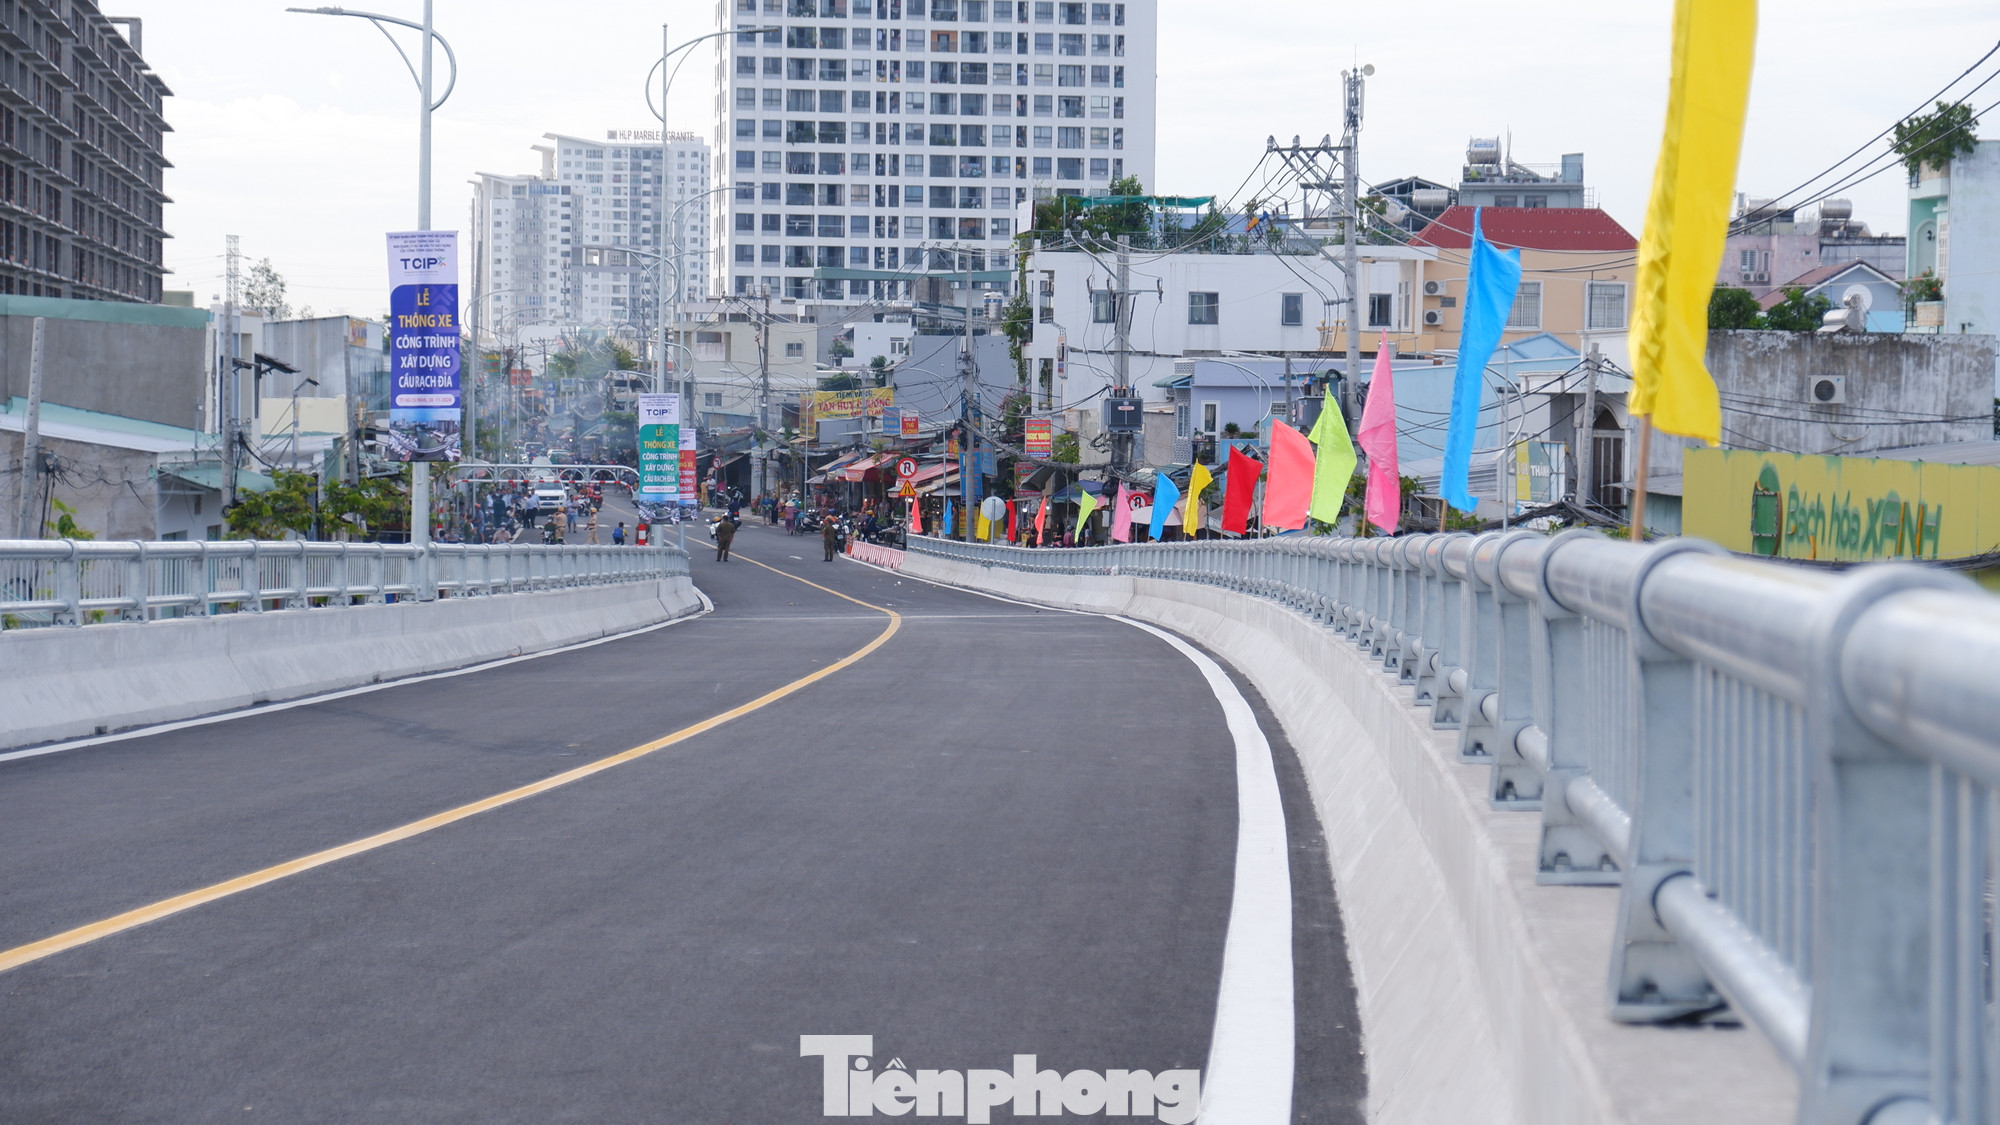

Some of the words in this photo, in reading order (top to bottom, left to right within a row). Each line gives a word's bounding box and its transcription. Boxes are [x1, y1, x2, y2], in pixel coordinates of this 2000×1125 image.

[619, 130, 632, 140] HLP
[633, 130, 660, 140] MARBLE
[667, 131, 695, 141] GRANITE
[400, 257, 438, 270] TCIP
[417, 288, 430, 306] LỄ
[398, 312, 436, 328] THÔNG
[438, 314, 453, 327] XE
[396, 334, 422, 349] CÔNG
[423, 333, 456, 348] TRÌNH
[400, 353, 418, 368] XÂY
[419, 353, 451, 371] DỰNG
[415, 375, 437, 391] RẠCH
[437, 372, 453, 388] ĐỈA
[646, 408, 669, 416] TCIP
[643, 440, 667, 449] THÔNG
[668, 441, 676, 449] XE
[642, 452, 659, 460] CÔNG
[660, 452, 678, 460] TRÌNH
[645, 463, 656, 471] XÂY
[657, 463, 675, 473] DỰNG
[1862, 495, 1943, 560] XANH
